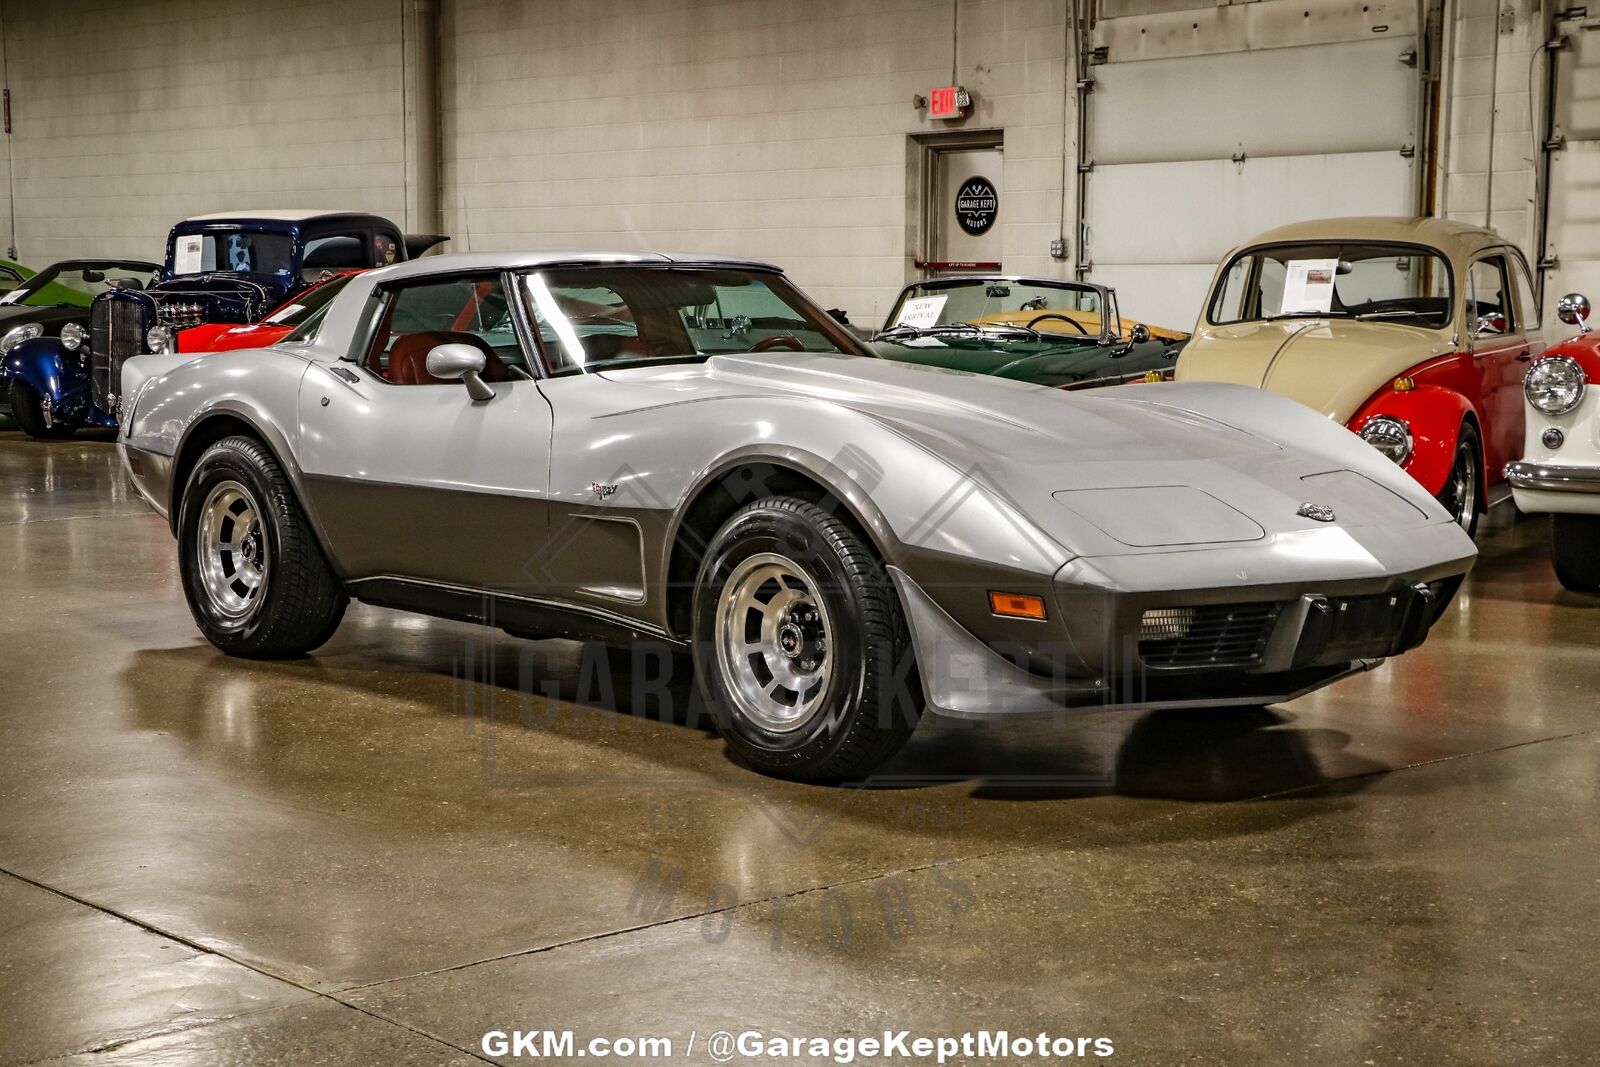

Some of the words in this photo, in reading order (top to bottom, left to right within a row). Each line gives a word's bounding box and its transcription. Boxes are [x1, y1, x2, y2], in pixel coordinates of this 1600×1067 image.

[931, 87, 955, 114] EXIT
[960, 199, 979, 208] GARAGE
[980, 199, 993, 208] KEPT
[912, 302, 931, 311] NEW
[903, 312, 935, 321] ARRIVAL
